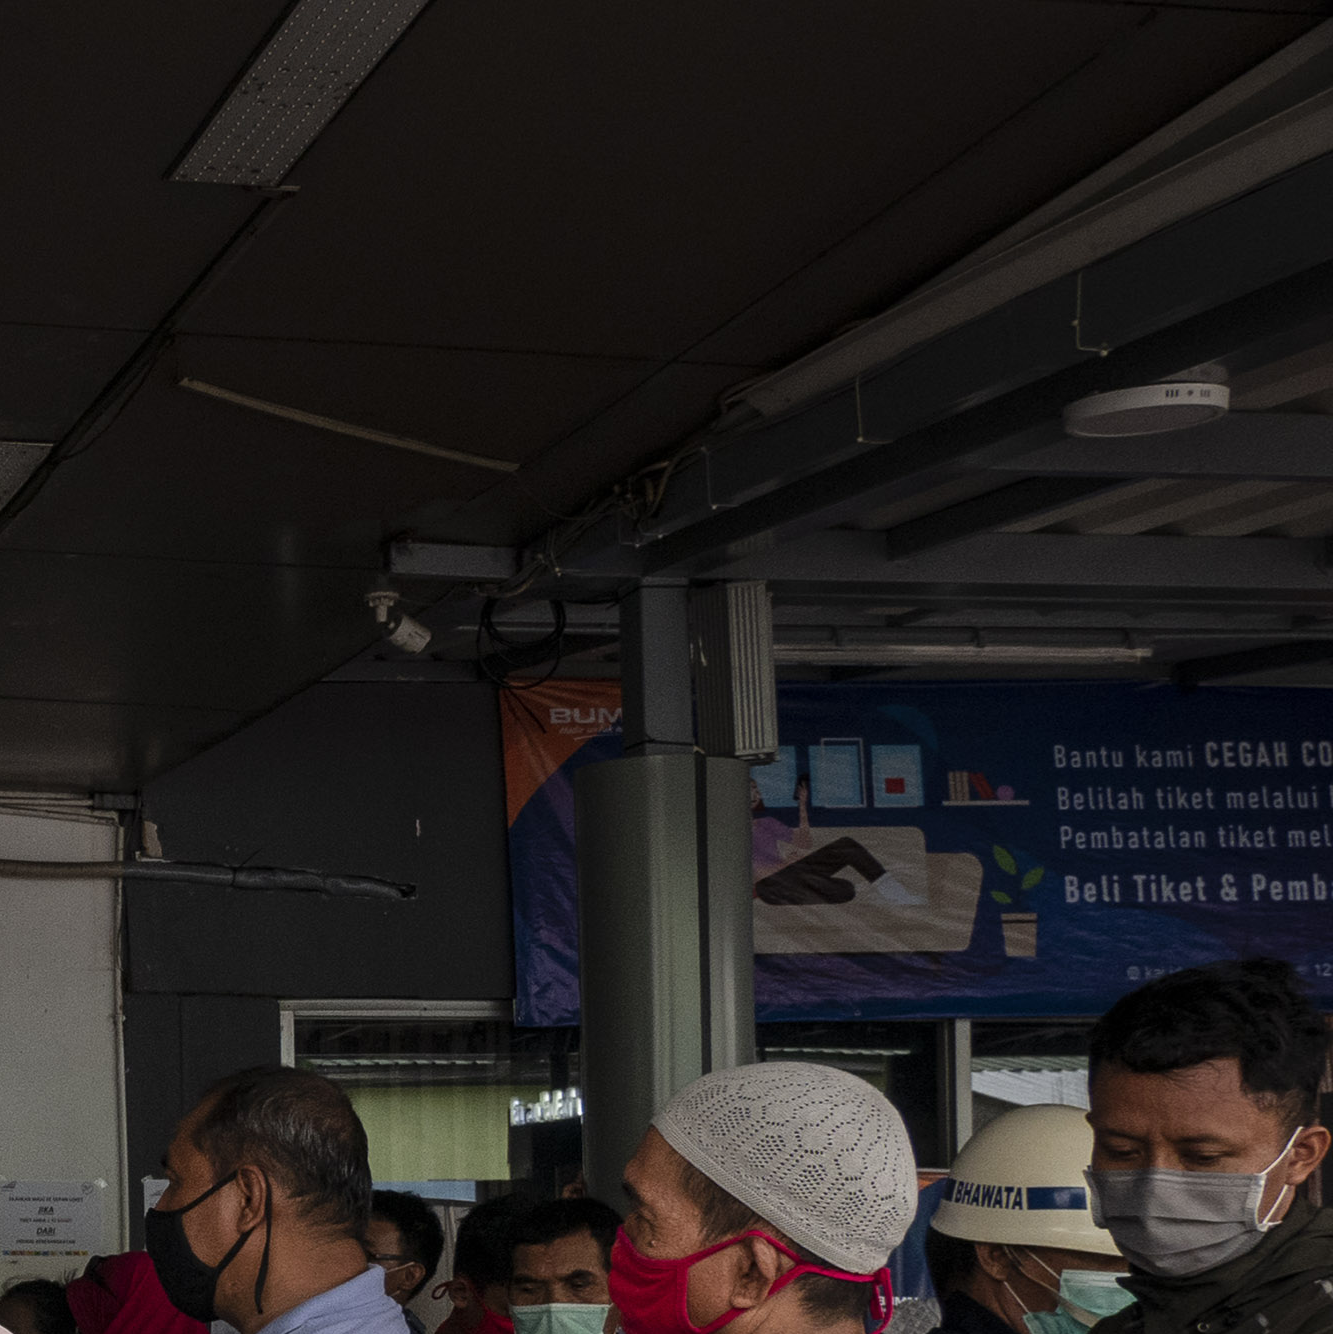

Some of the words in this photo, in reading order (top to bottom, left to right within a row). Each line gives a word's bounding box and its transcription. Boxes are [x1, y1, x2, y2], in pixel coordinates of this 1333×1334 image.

[1053, 744, 1124, 769] Bantu
[1135, 744, 1194, 768] kami
[1205, 741, 1289, 768] CEGAH
[1057, 785, 1145, 811] Belilah
[1156, 786, 1215, 810] tiket
[1226, 785, 1319, 809] melalui
[1059, 825, 1207, 850] Pembatalan
[1218, 825, 1277, 849] tiket
[1064, 874, 1121, 904] Beli
[1132, 874, 1207, 903] Tiket
[1219, 873, 1239, 902] &
[1251, 873, 1333, 902] Pemb
[954, 1180, 1023, 1210] BHAWATA
